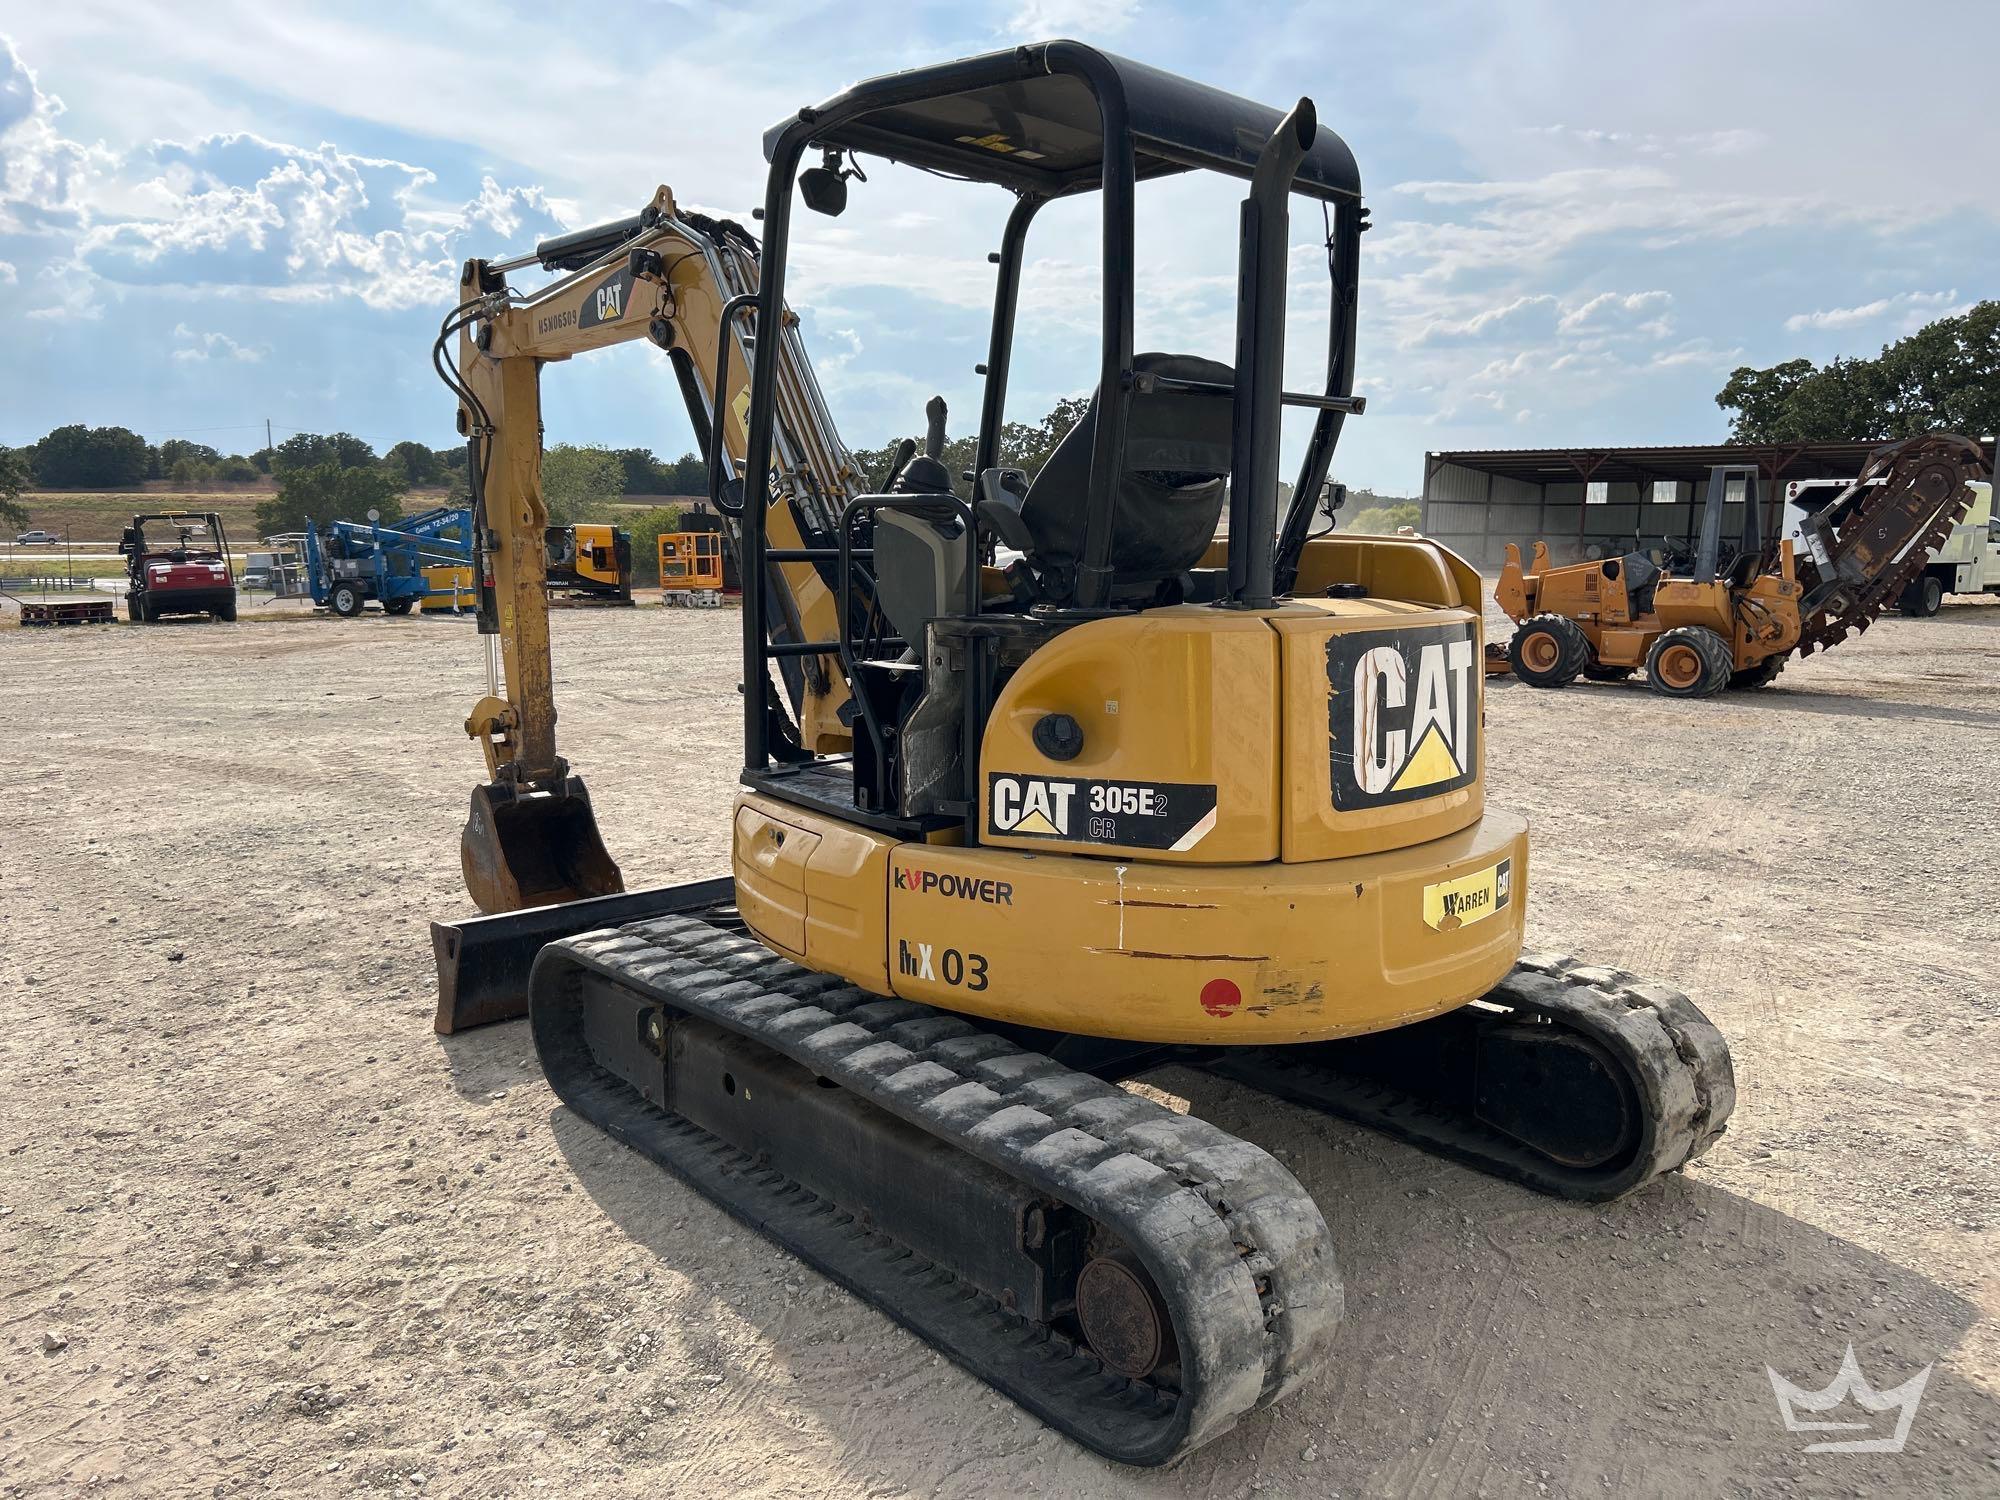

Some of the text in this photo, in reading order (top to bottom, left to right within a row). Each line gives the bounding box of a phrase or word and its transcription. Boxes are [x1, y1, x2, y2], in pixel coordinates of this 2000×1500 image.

[597, 284, 622, 320] CAT
[415, 524, 431, 535] Genie
[1353, 640, 1472, 795] CAT
[994, 778, 1168, 835] CAT 305E2
[1089, 817, 1116, 839] CR
[1442, 870, 1510, 917] WARREN CAT
[941, 948, 989, 992] 03
